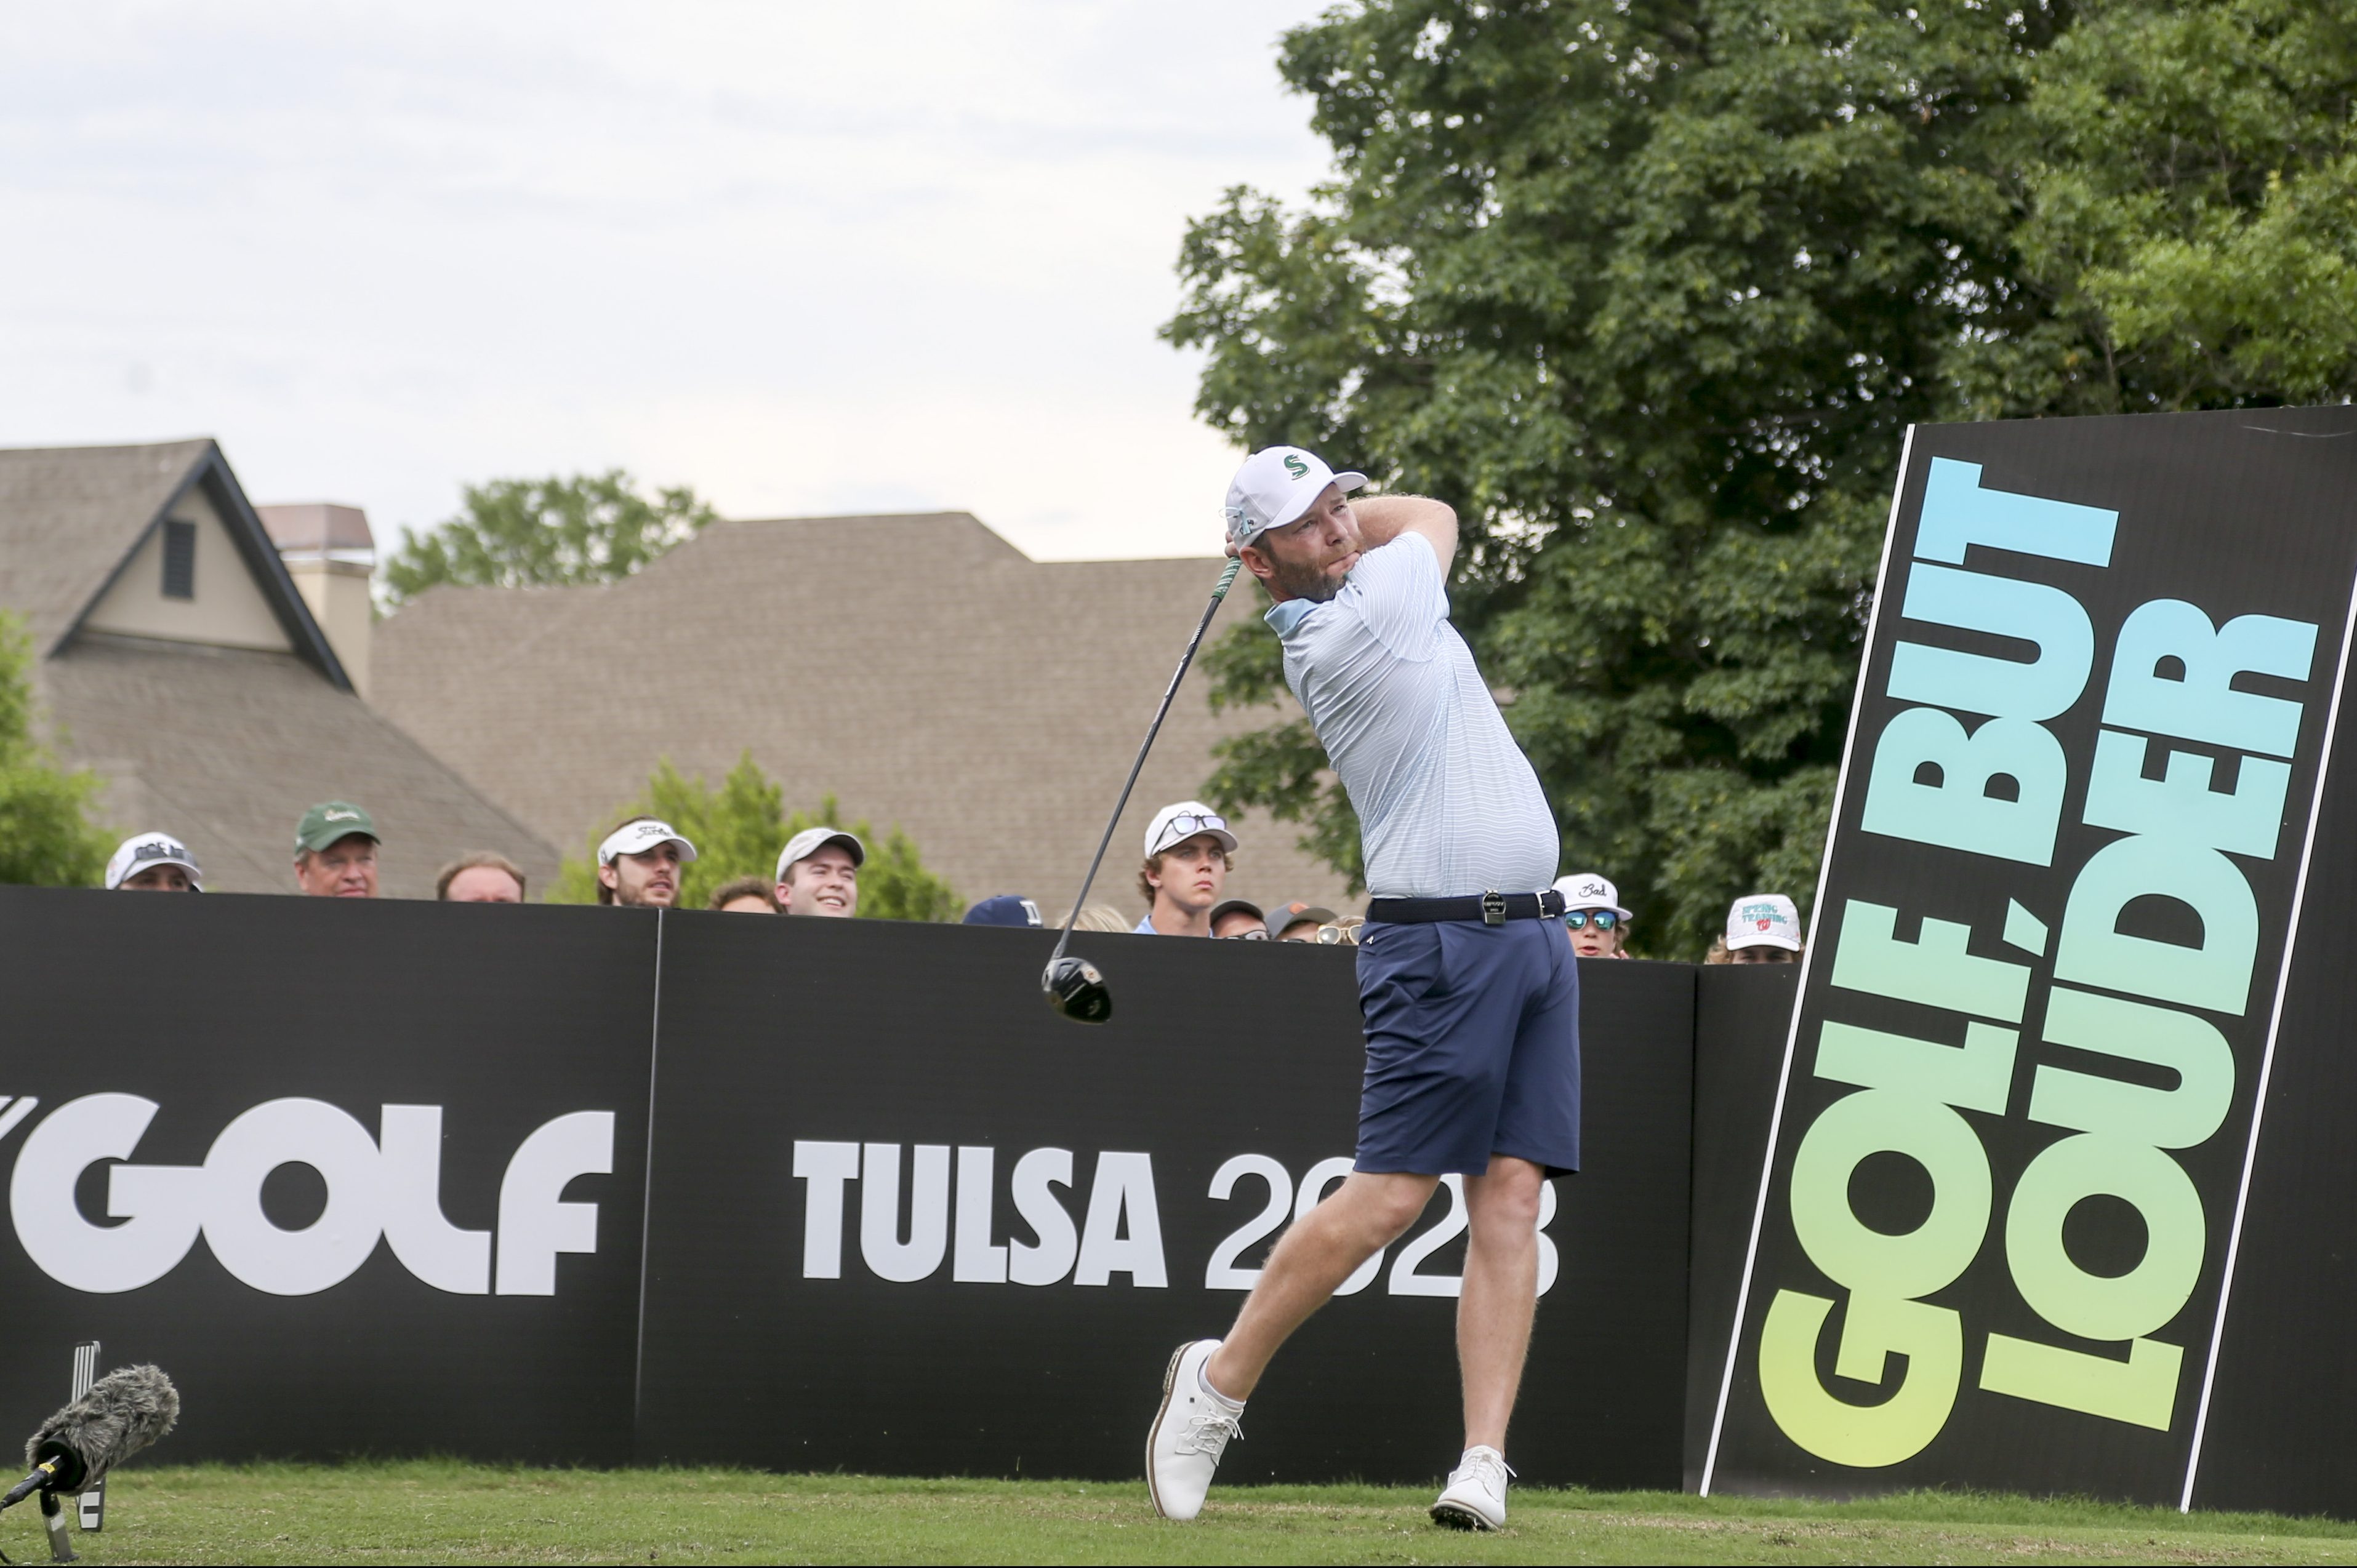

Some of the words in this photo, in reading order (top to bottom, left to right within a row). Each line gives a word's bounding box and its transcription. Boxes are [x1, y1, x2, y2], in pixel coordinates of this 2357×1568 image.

[1283, 454, 1310, 481] S
[1860, 456, 2119, 868] BUT
[1578, 883, 1607, 898] Bad
[1741, 913, 1788, 926] TRAINING
[1742, 903, 1778, 915] SPRING
[1978, 598, 2319, 1432] LOUDER
[9, 1092, 616, 1296] GOLF
[792, 1140, 1168, 1288] TULSA
[1205, 1153, 1559, 1298] 22
[1759, 897, 2049, 1468] GOLF,
